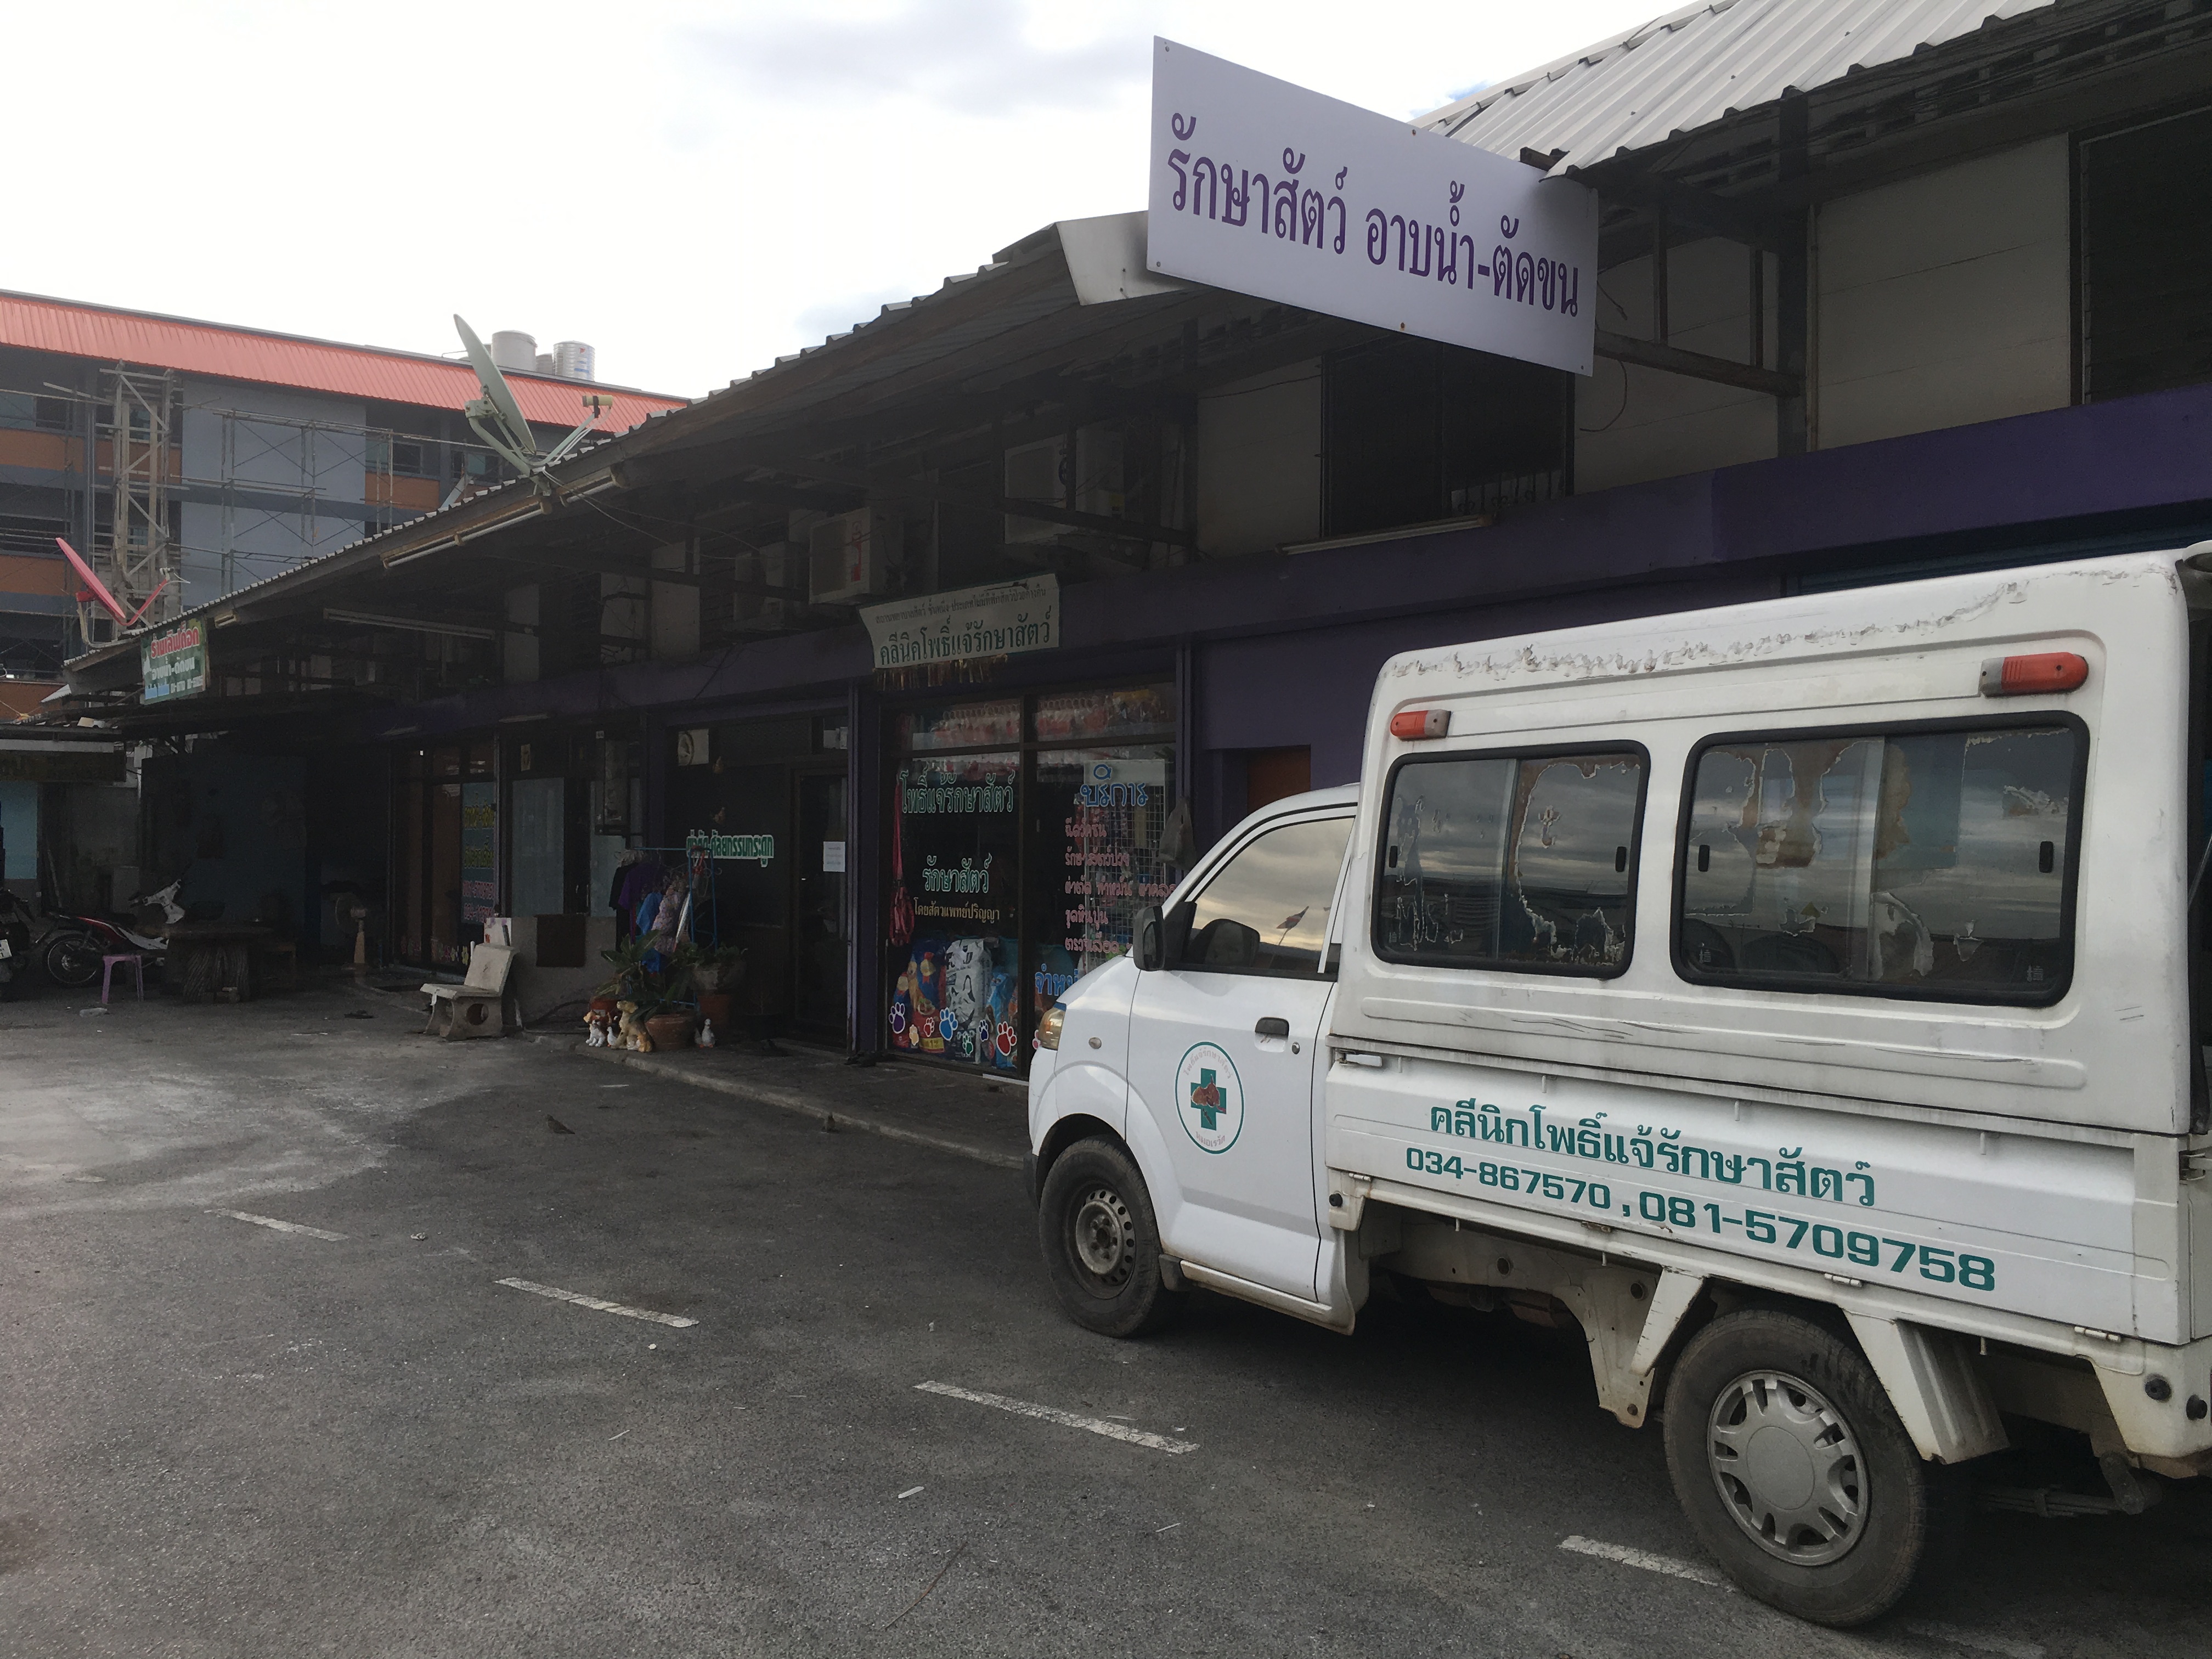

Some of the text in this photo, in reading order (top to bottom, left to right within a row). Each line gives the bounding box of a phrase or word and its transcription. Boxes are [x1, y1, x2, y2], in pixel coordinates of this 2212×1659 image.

[1167, 112, 1578, 318] รักษาสัตว์ อาบน้ำ-ตัดขน
[876, 603, 926, 624] สถานพยาบาลสัตว์
[880, 605, 1051, 665] คลีนิคโพธิ์แจ้รักษาสัตว์
[899, 760, 1015, 814] โพธิ์แจ้รักษาสัตว์
[1080, 763, 1148, 808] บริการ
[1064, 816, 1107, 838] ฉีดวัคซีน
[922, 852, 993, 894] รักษาสัตว์
[1064, 844, 1130, 867] รักษาสัตว์ป่วย
[1064, 874, 1092, 895] ผ่าตัด
[913, 896, 1000, 924] โดยสัตวแพทย์ปริญญา
[1065, 904, 1109, 930] ขูดหินปูน
[1430, 1097, 1875, 1207] คลีนิกโพธิ์แจ้รักษาสัตว์
